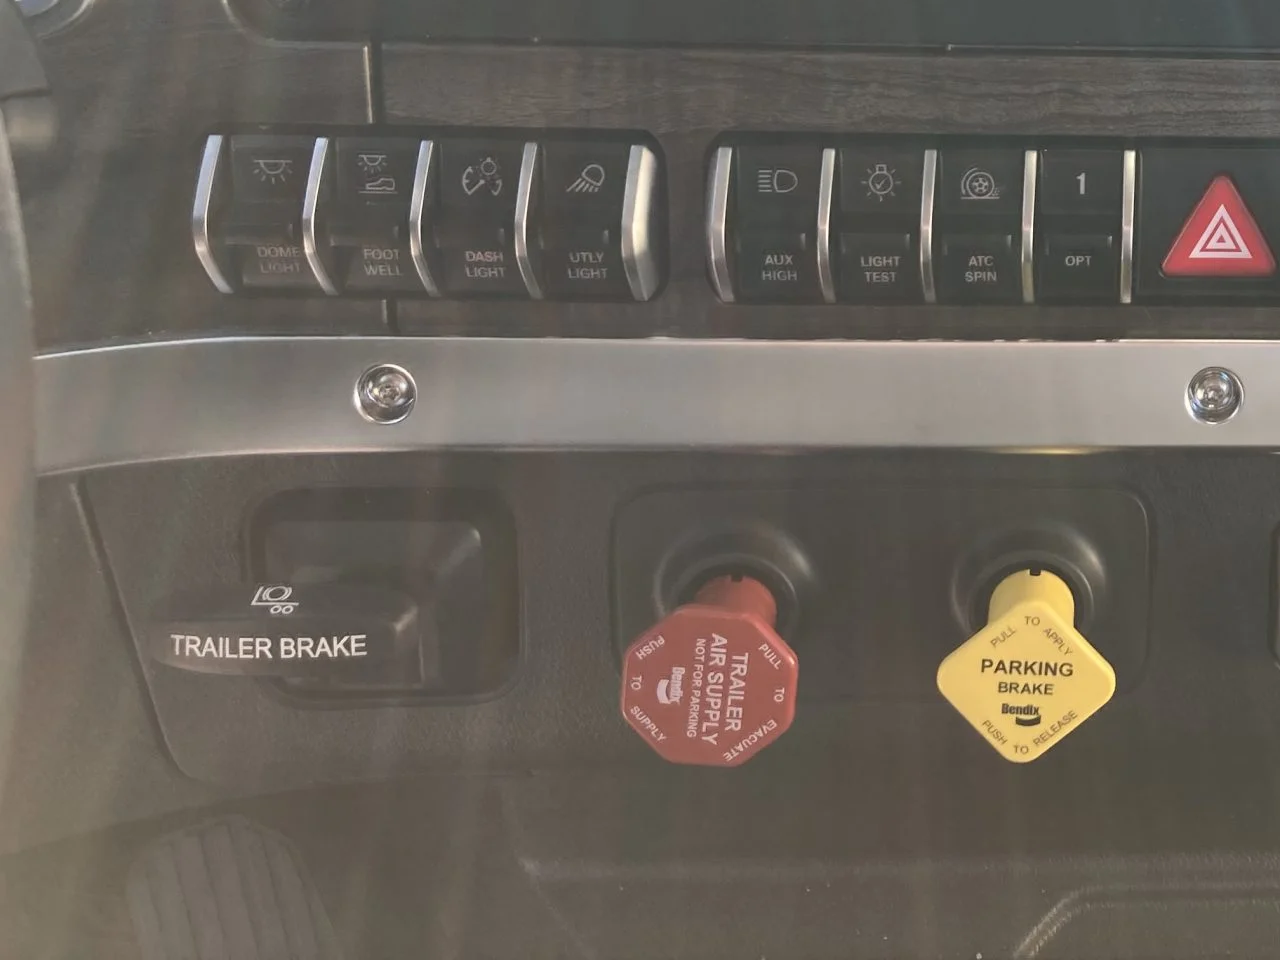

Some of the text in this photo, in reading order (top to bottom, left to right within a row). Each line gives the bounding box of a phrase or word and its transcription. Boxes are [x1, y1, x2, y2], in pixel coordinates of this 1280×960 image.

[1076, 172, 1086, 195] 1
[257, 247, 300, 259] DOME
[363, 248, 400, 260] FOOT
[465, 250, 503, 263] DASH
[569, 251, 605, 264] UTLY
[764, 254, 794, 267] AUX
[860, 255, 901, 268] LIGHT
[968, 255, 994, 267] ATC
[1065, 255, 1092, 267] OPT
[259, 262, 301, 275] LIGHT
[364, 263, 403, 276] WELL
[465, 266, 505, 279] LIGHT
[567, 267, 608, 280] LIGHT
[761, 269, 798, 282] HIGH
[864, 270, 897, 283] TEST
[964, 270, 998, 283] SPIN
[990, 616, 1073, 656] PULL TO APPLY
[170, 634, 367, 659] TRAILER BRAKE
[981, 658, 1074, 677] PARKING
[630, 635, 667, 742] PUSH TO SUPPLY
[670, 667, 685, 705] Bendix
[687, 638, 706, 738] NOT FOR PARKING
[702, 633, 728, 745] AIR SUPPLY
[724, 652, 749, 732] TRAILER
[997, 681, 1054, 695] BRAKE
[723, 643, 785, 762] PULL TO EVACUATE
[1001, 703, 1040, 715] Bendix
[982, 710, 1078, 755] PUSH TO RELEASE
